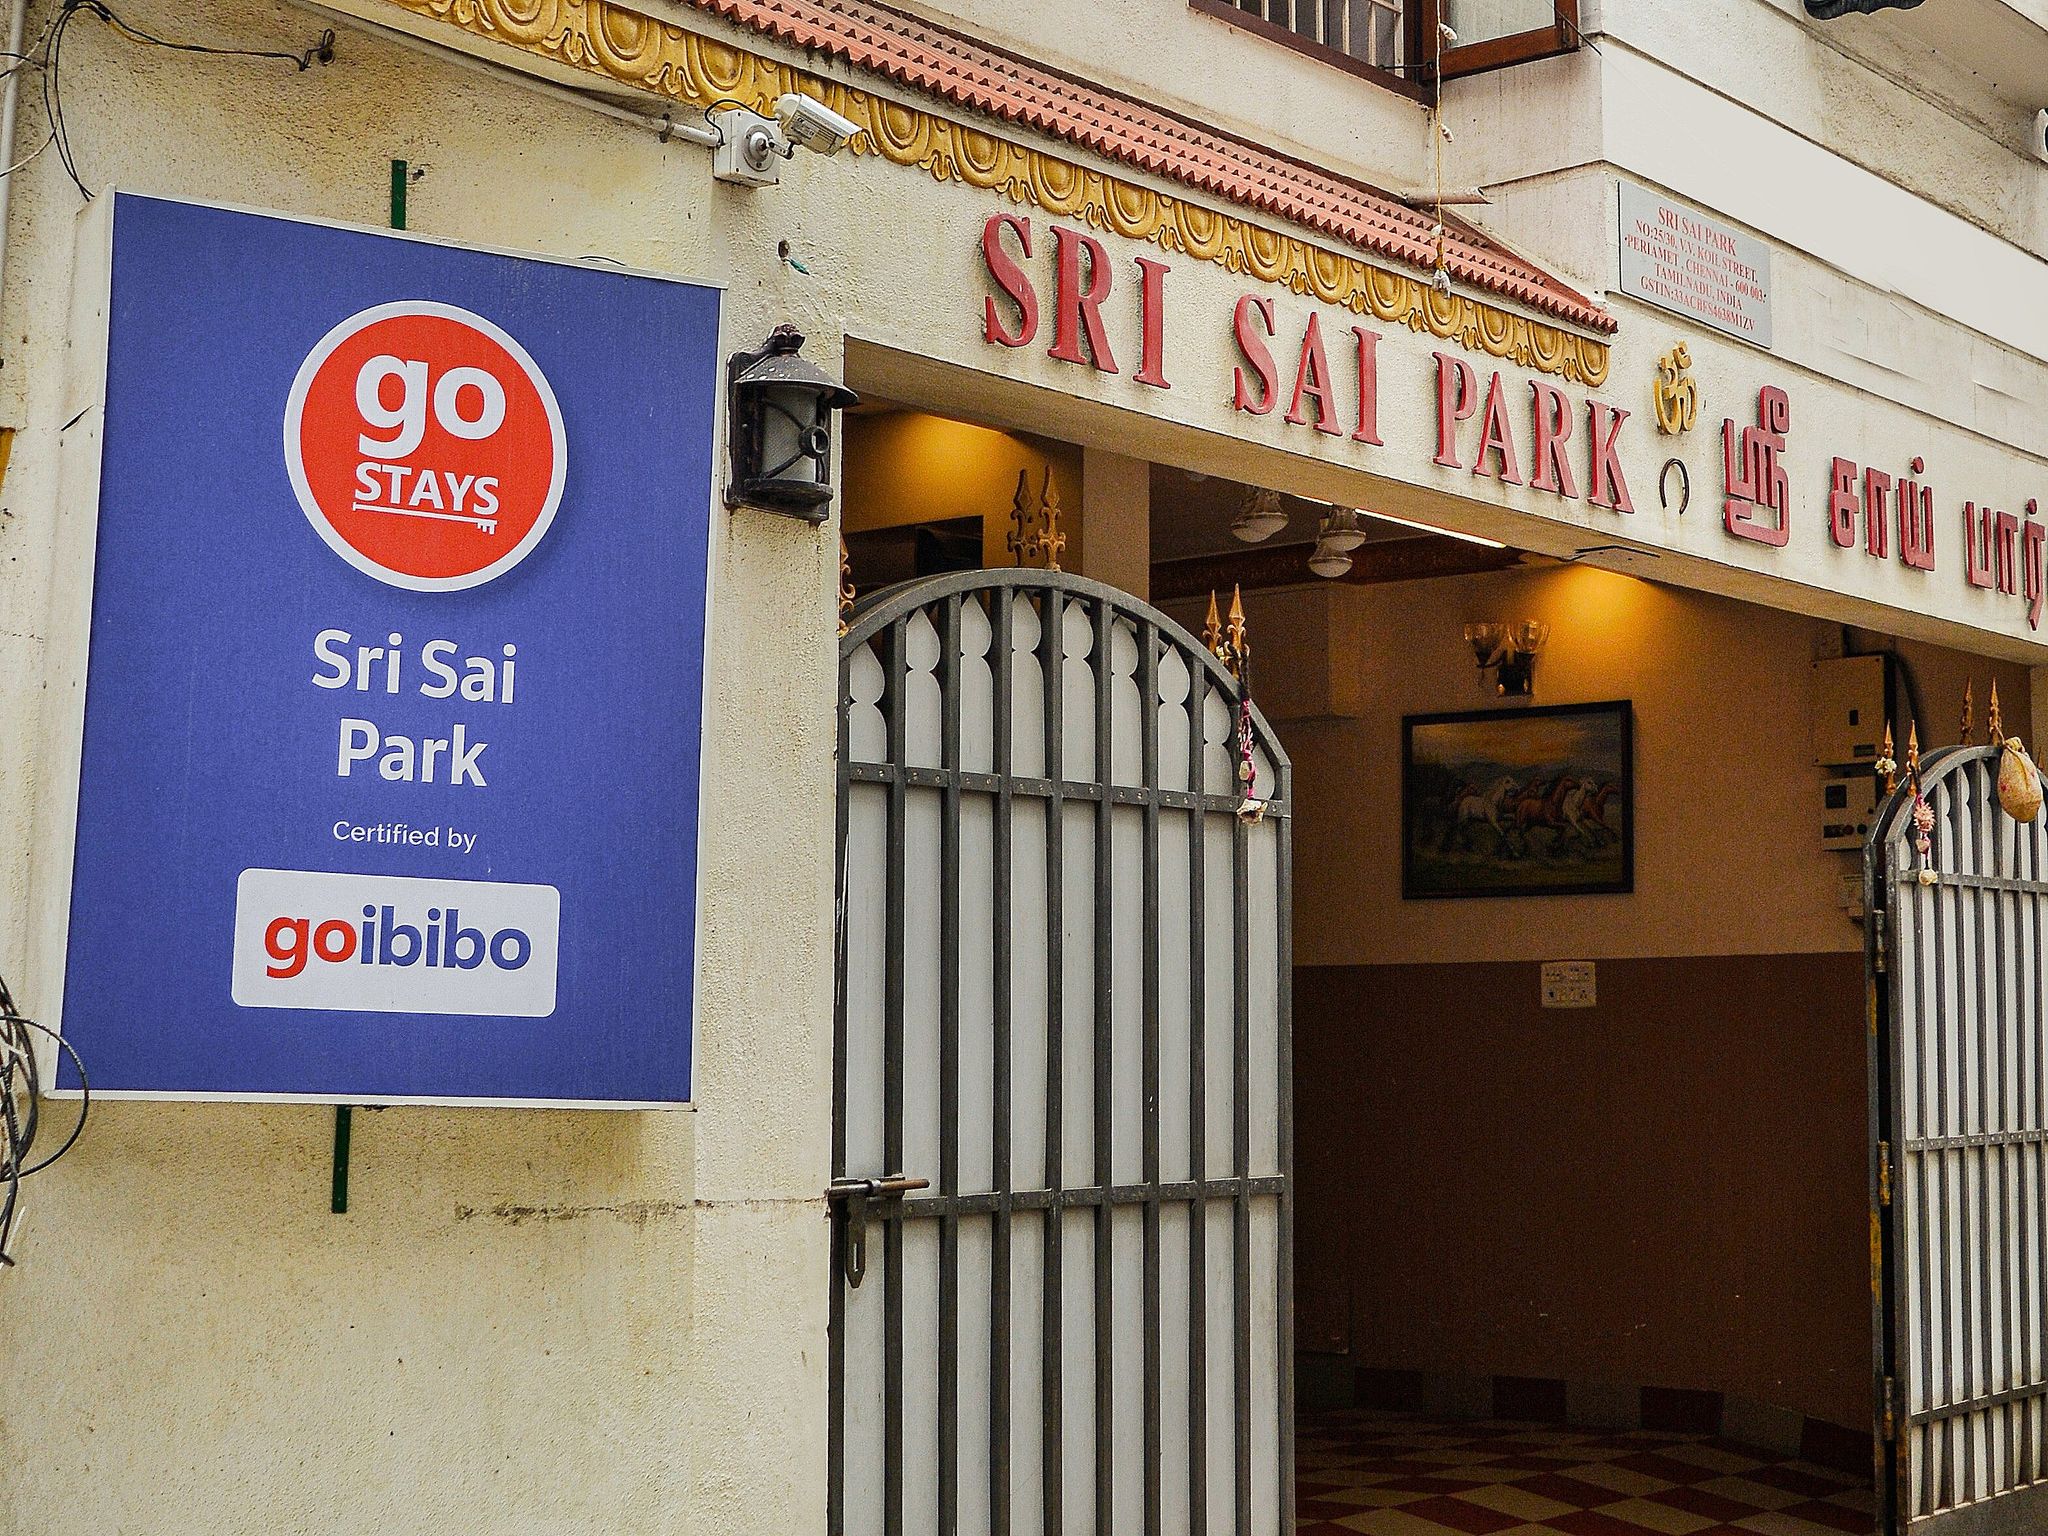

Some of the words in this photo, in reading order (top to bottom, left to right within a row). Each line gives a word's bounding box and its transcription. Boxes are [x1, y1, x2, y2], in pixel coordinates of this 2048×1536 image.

[1657, 206, 1680, 231] SRI
[1682, 216, 1701, 241] SAI
[1705, 226, 1737, 257] PARK
[1697, 245, 1721, 267] KOIL
[1685, 258, 1729, 288] CHENNAI
[1716, 288, 1743, 311] INDIA
[984, 212, 1171, 389] SRI
[1233, 293, 1384, 447] SAI
[1431, 350, 1634, 515] PARK
[355, 355, 506, 459] go
[355, 462, 499, 516] STAYS
[1830, 456, 1935, 572] சாய்
[311, 629, 403, 694] Sri
[419, 639, 517, 704] Sai
[337, 718, 489, 787] Park
[332, 820, 440, 848] Certified
[447, 827, 478, 854] by
[264, 904, 532, 979] goibibo
